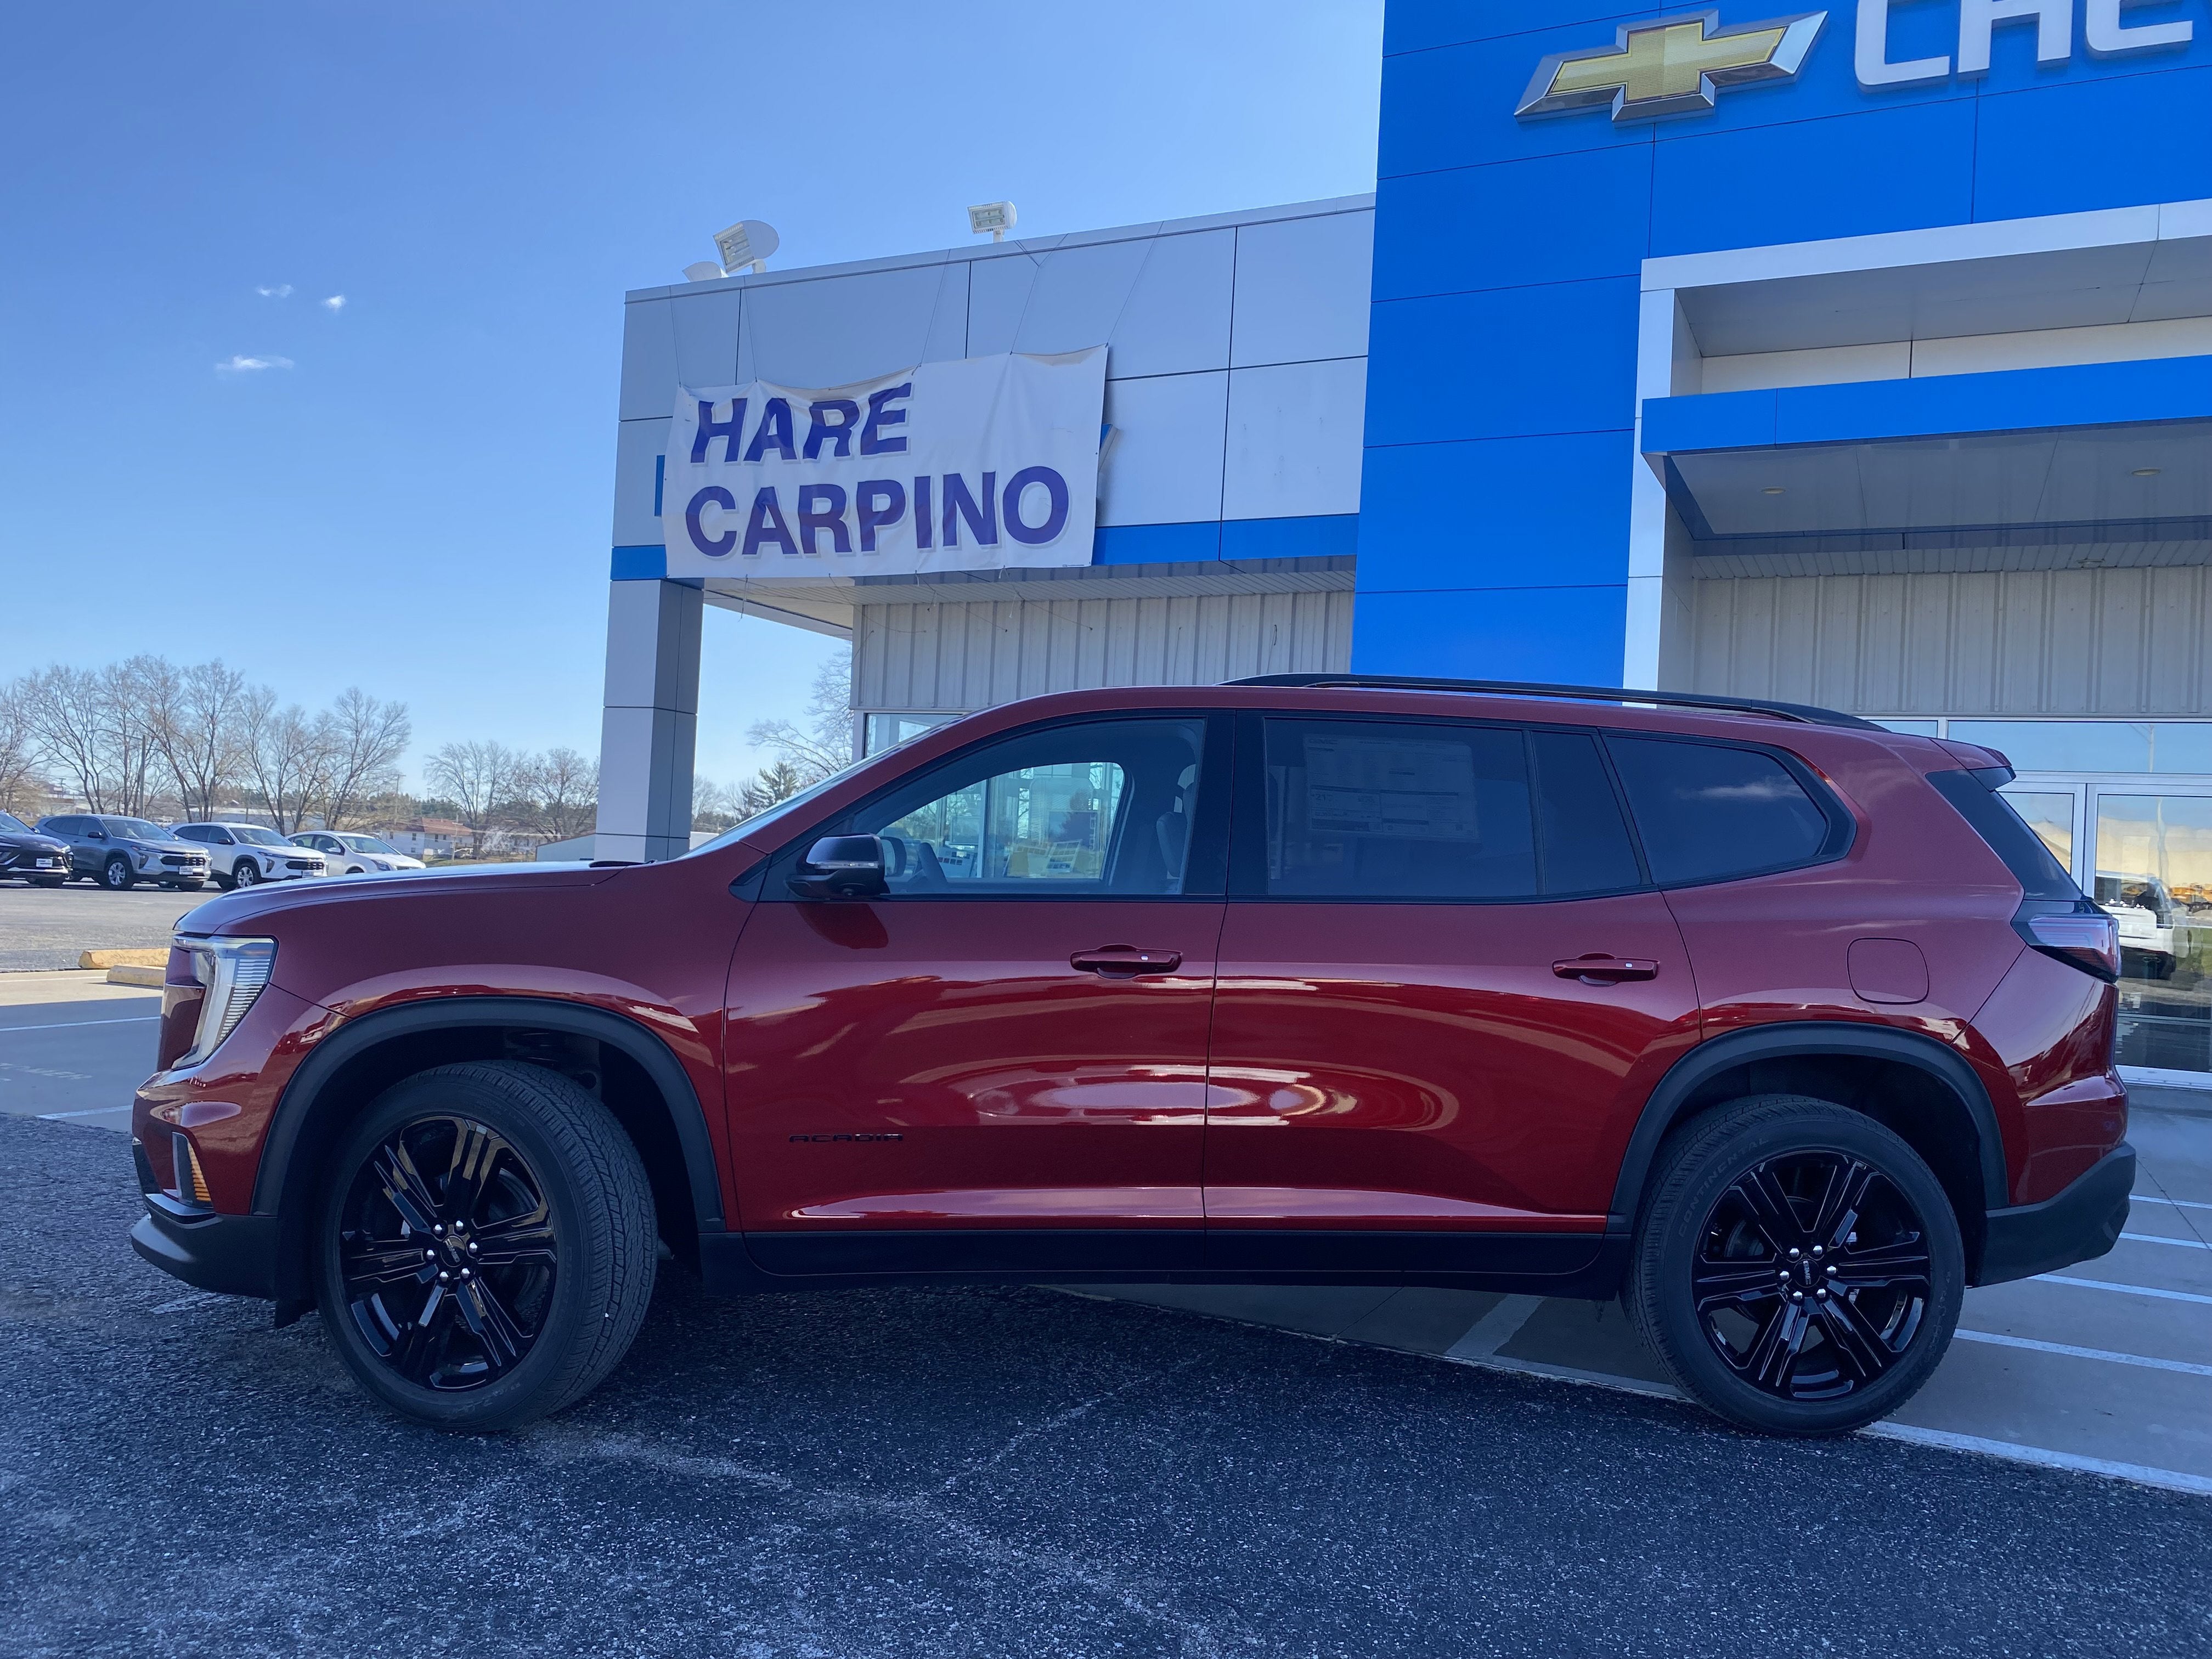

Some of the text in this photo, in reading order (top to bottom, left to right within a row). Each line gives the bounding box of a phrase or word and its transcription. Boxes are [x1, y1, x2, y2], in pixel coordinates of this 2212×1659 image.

[690, 382, 912, 465] HARE
[685, 466, 1069, 557] CARPINO
[789, 1133, 903, 1143] ACADIA
[1678, 1137, 1769, 1238] CONTINENTAL
[1803, 1260, 1812, 1285] GMC
